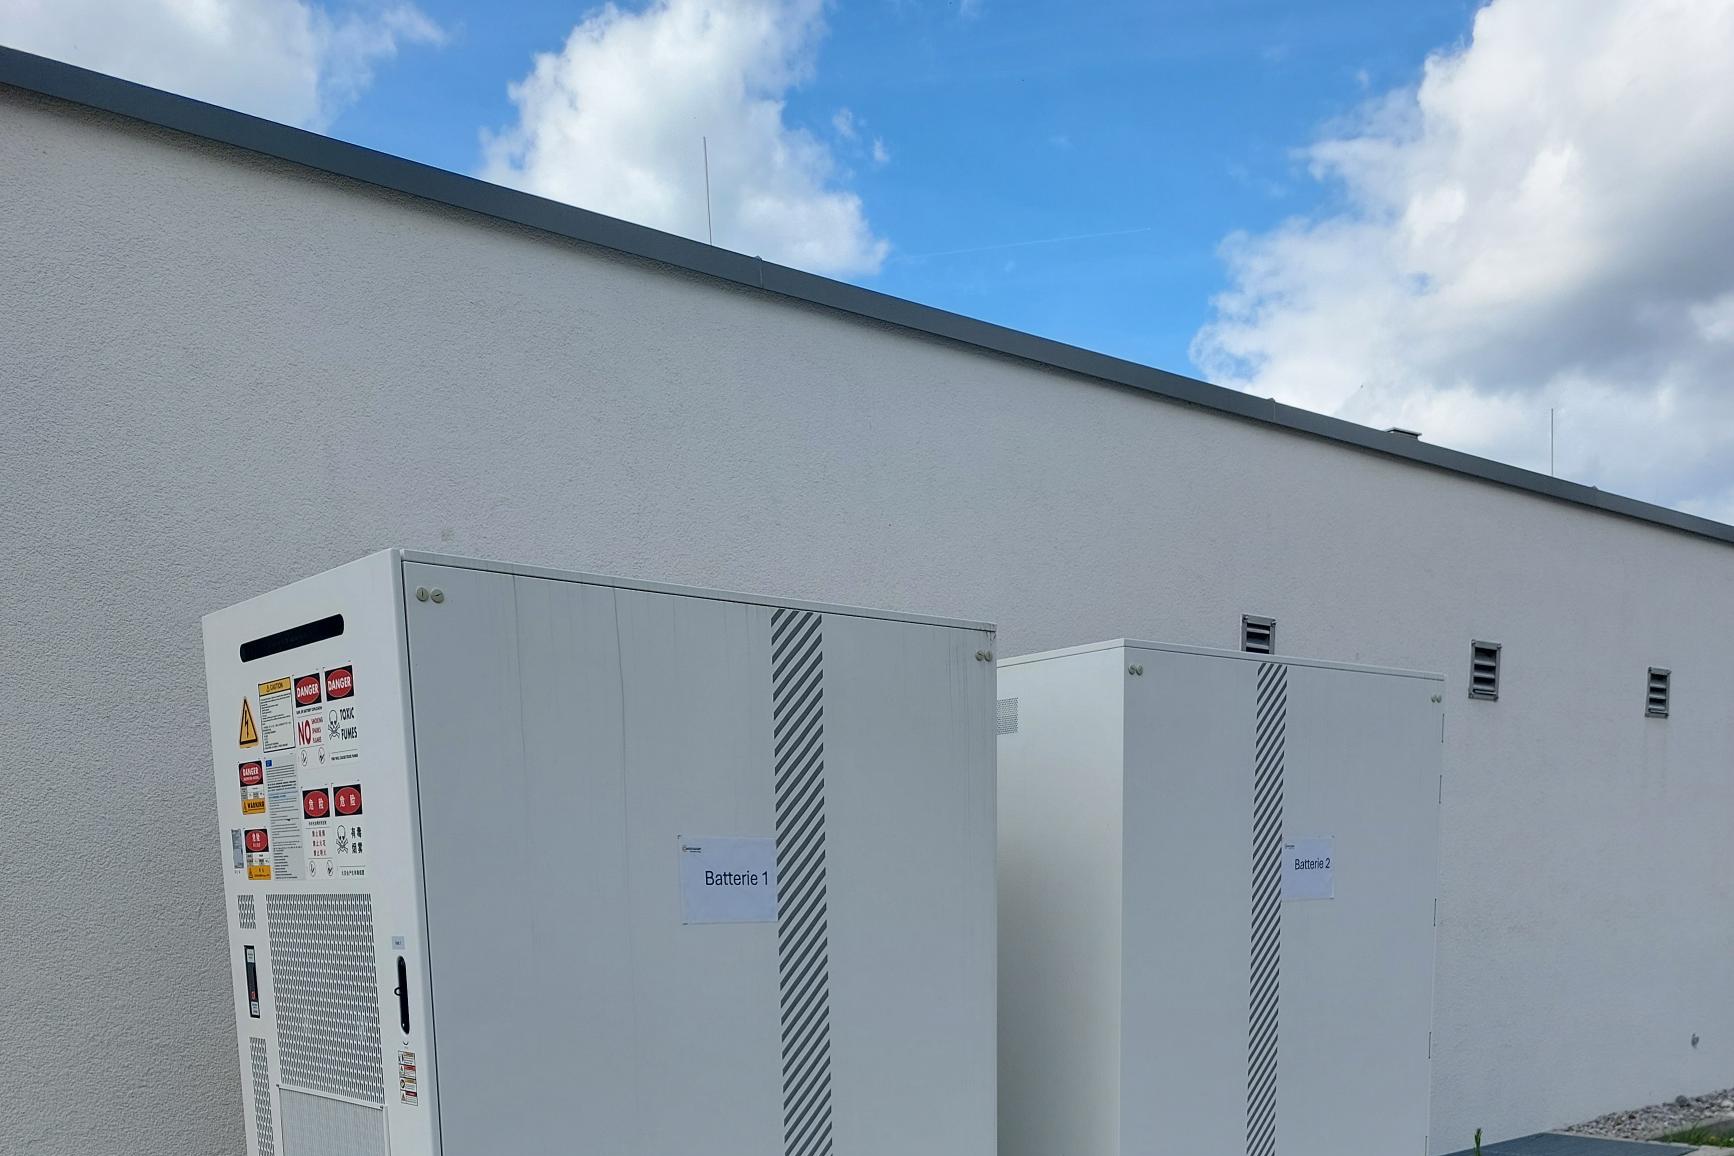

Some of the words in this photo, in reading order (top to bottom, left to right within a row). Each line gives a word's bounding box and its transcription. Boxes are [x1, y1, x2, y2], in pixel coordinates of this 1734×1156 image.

[296, 683, 319, 698] DANGER
[327, 676, 351, 691] DANGER
[340, 707, 354, 720] TOXIC
[298, 720, 311, 745] NO
[341, 726, 358, 740] FUMES
[1294, 858, 1324, 870] Batterie
[1325, 857, 1331, 869] 2
[704, 870, 758, 886] Batterie
[762, 870, 768, 885] 1
